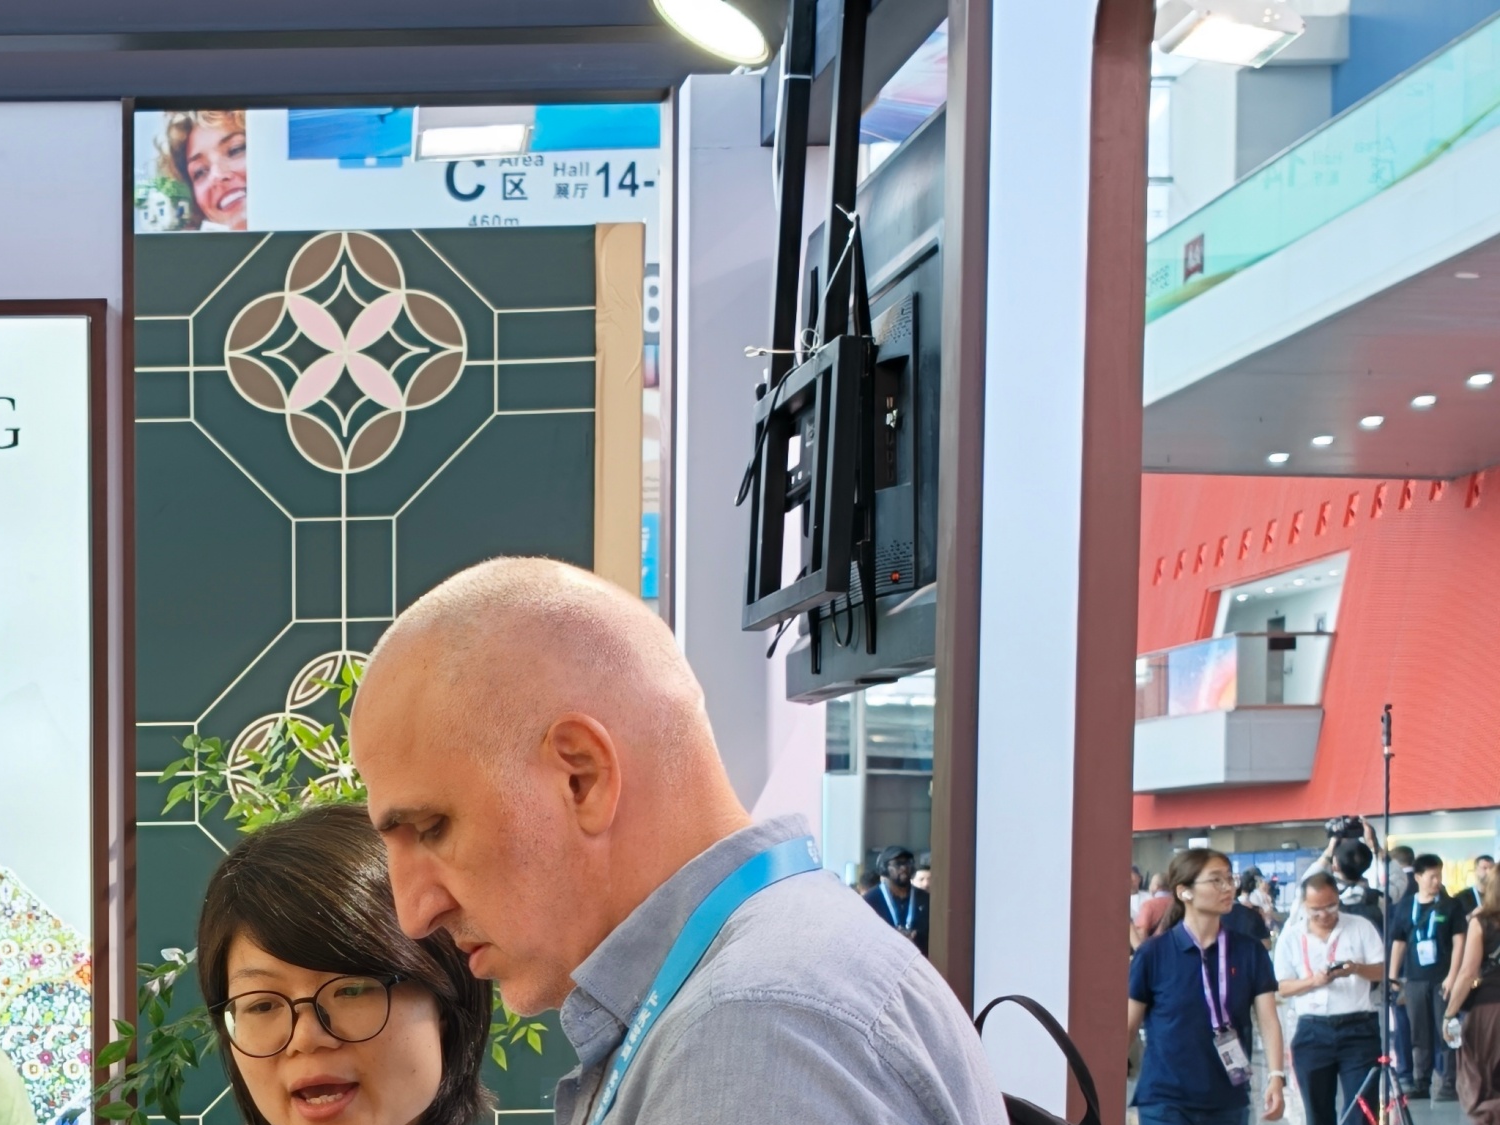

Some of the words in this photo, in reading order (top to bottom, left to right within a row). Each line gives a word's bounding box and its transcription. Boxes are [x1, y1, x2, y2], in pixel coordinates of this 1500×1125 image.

[445, 160, 486, 202] C
[553, 162, 590, 177] Hall
[596, 161, 661, 198] 14-
[502, 172, 528, 200] 区
[554, 183, 589, 199] 展厅
